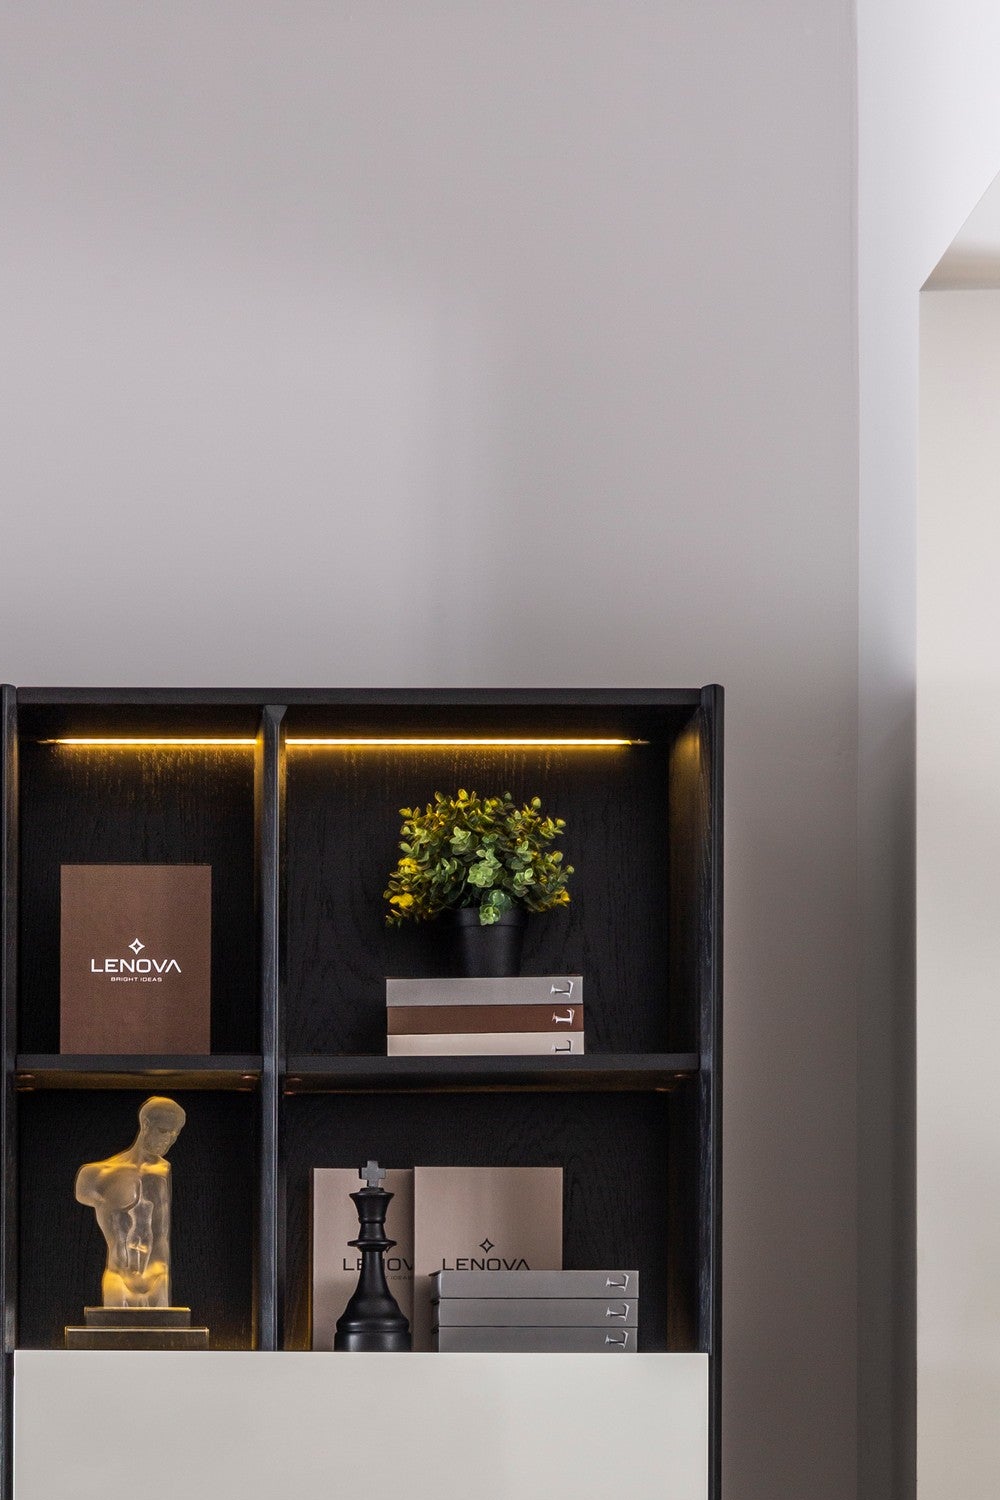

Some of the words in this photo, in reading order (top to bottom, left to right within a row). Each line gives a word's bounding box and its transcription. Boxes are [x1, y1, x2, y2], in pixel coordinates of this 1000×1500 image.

[90, 958, 182, 973] LENOVA
[550, 980, 574, 999] L
[552, 1007, 575, 1026] L
[554, 1039, 572, 1054] L
[442, 1258, 530, 1271] LENOVA
[606, 1273, 629, 1292] L
[606, 1303, 630, 1322] L
[605, 1330, 629, 1349] L
